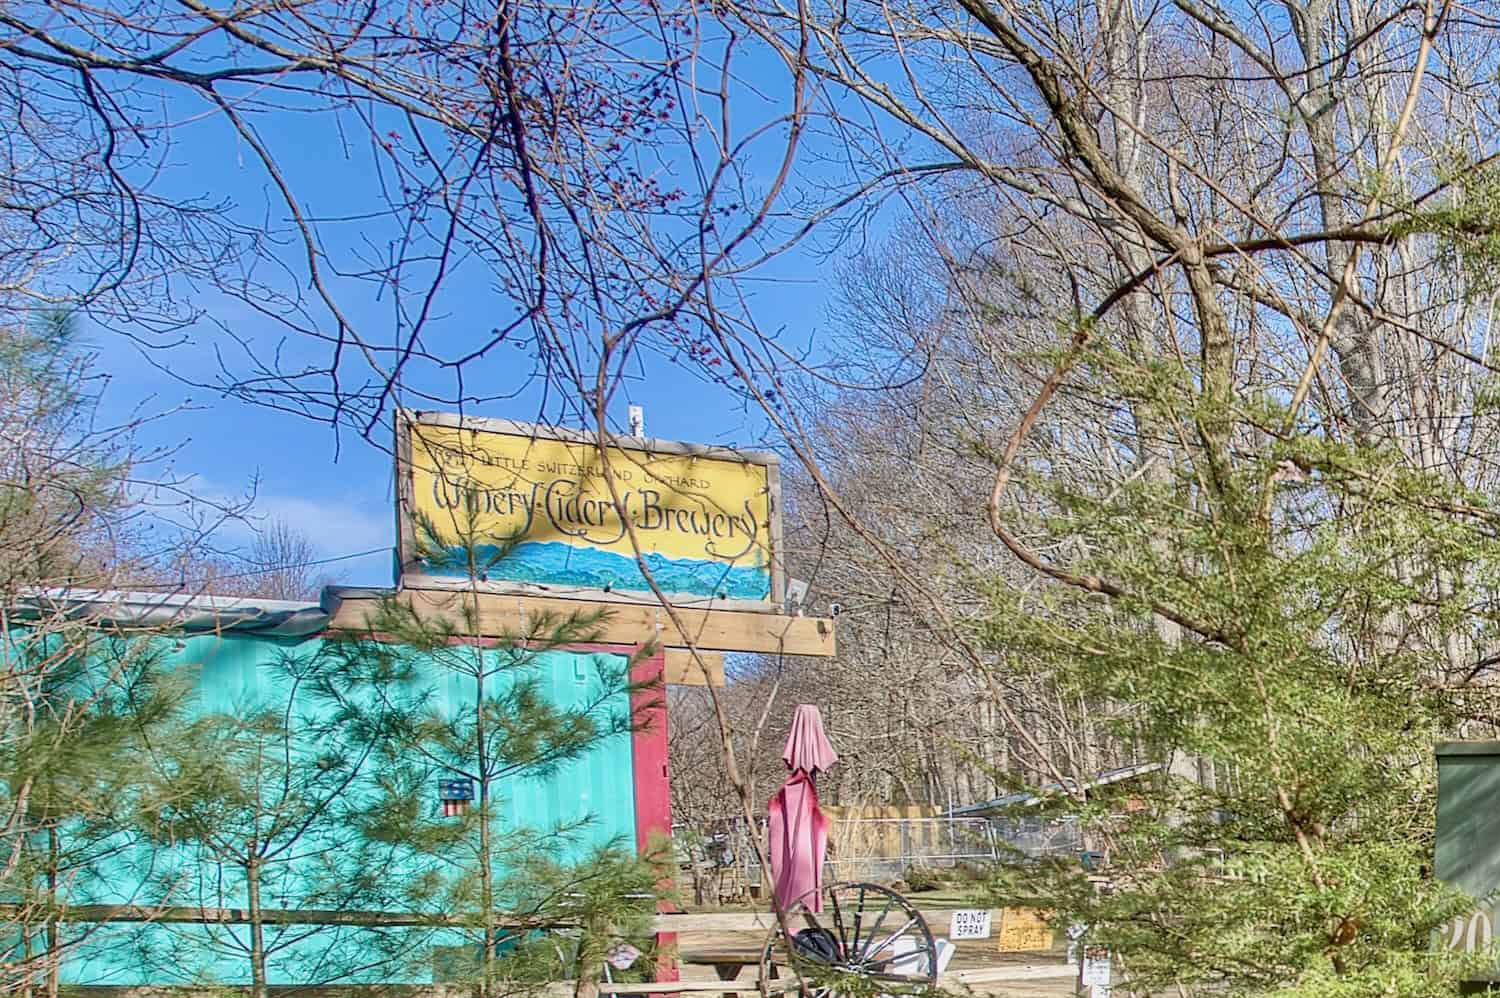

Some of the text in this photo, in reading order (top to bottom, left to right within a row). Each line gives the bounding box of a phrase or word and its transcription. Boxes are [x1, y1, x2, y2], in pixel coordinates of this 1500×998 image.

[537, 461, 633, 481] SWITZERLND
[546, 479, 630, 544] Cidery
[637, 488, 758, 559] Brewery
[957, 911, 987, 924] DO NOT
[957, 925, 984, 936] SPRAY
